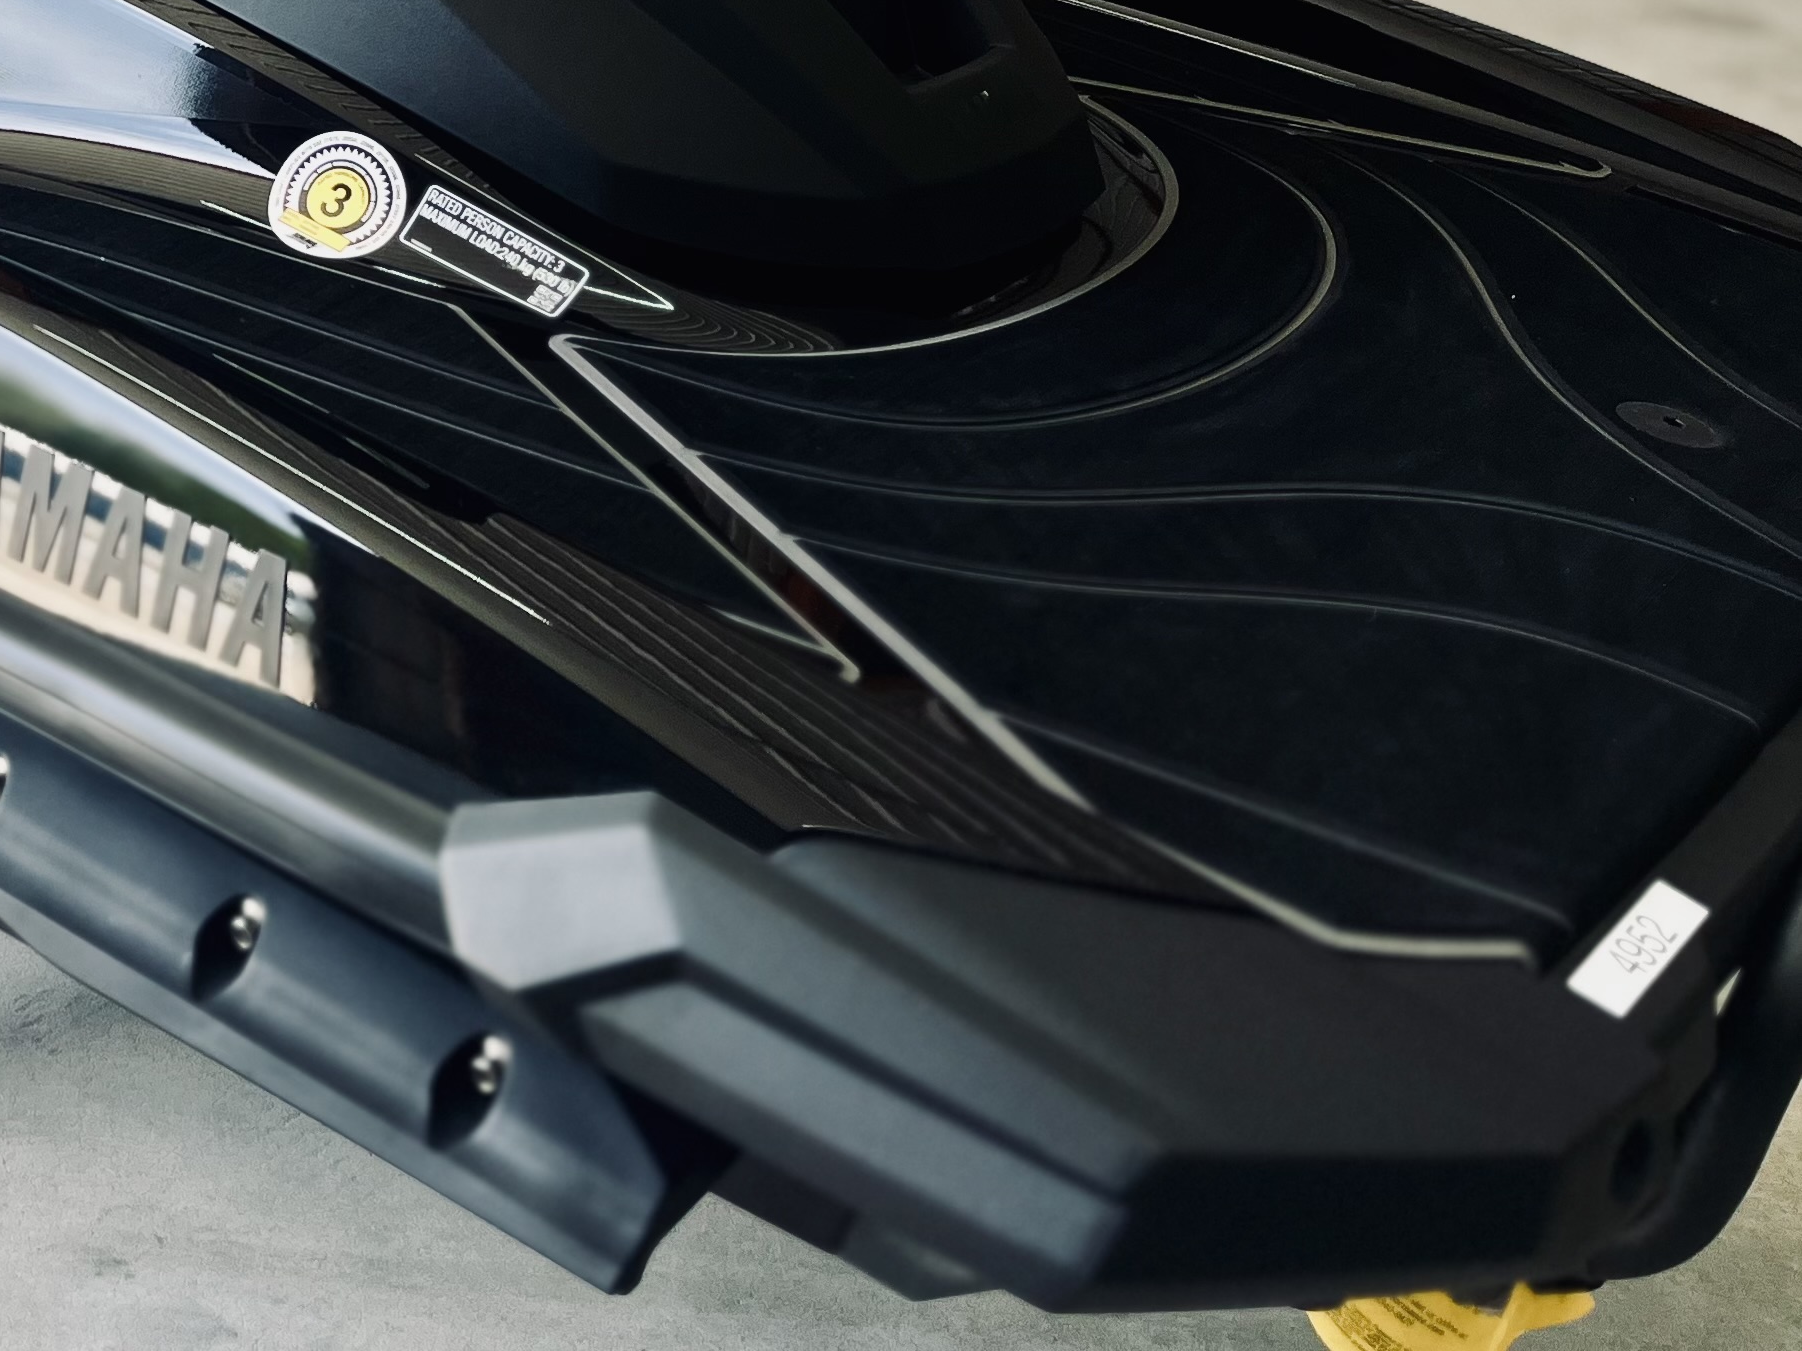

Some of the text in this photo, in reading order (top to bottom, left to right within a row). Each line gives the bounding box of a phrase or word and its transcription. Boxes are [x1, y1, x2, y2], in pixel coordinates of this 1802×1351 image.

[320, 182, 352, 218] 3
[427, 189, 566, 273] RATED PERSON CAPACITY: 3
[419, 203, 473, 240] MAXIMUM
[517, 260, 535, 277] kg
[1609, 915, 1678, 974] 4952
